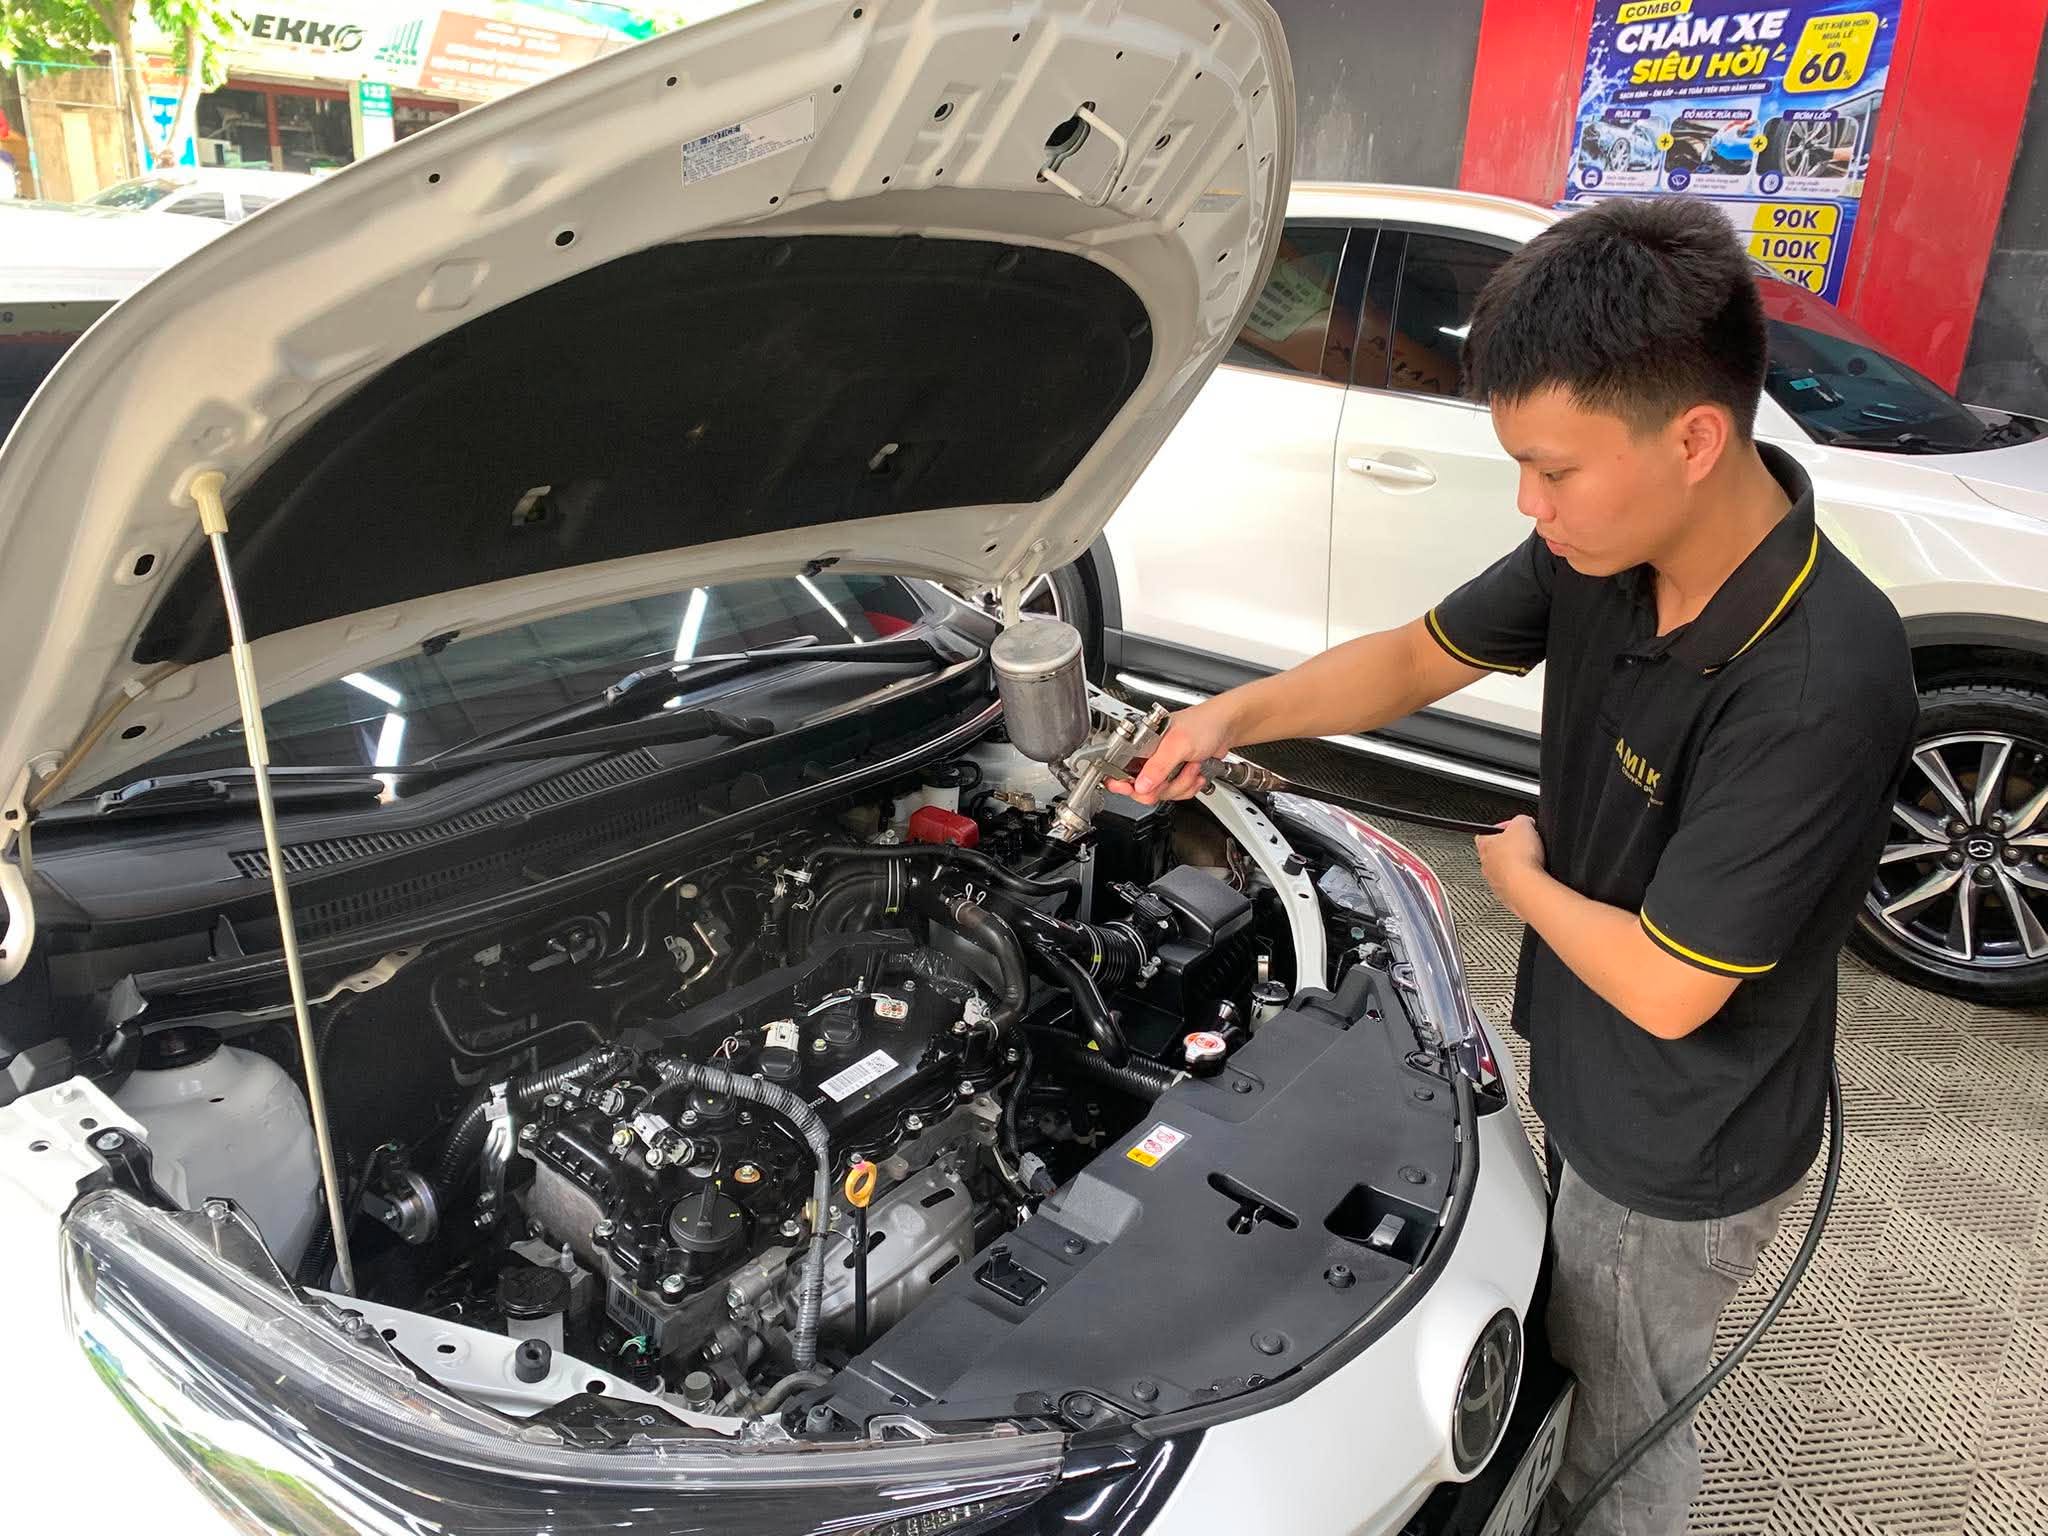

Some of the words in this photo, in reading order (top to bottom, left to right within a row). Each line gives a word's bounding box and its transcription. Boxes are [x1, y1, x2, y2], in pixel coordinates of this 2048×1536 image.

[1626, 1, 1681, 18] COMBO
[1616, 12, 1729, 53] CHĂM
[1727, 8, 1791, 43] XE
[1822, 32, 1841, 40] MUA
[1630, 51, 1703, 85] SIÊU
[1705, 44, 1770, 79] HỜI
[1773, 208, 1820, 229] 90K
[1762, 238, 1820, 259] 100K
